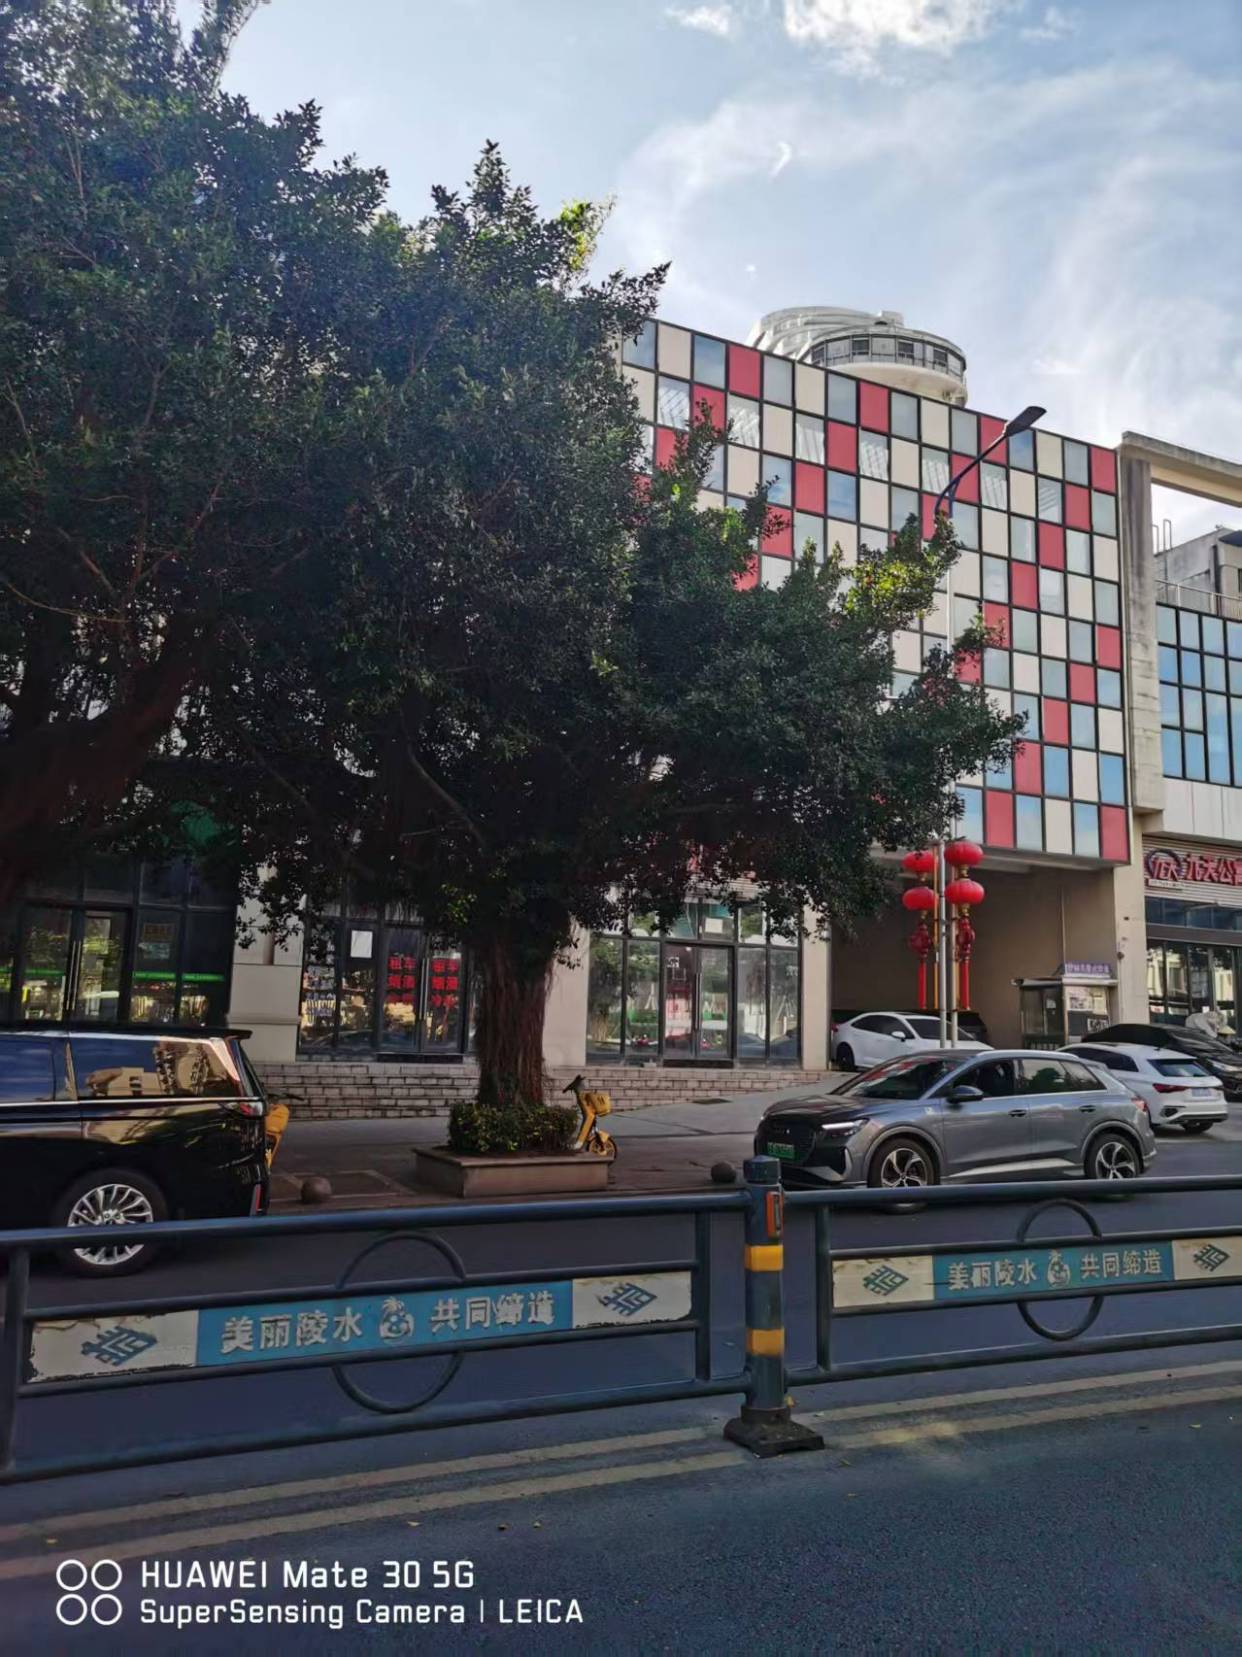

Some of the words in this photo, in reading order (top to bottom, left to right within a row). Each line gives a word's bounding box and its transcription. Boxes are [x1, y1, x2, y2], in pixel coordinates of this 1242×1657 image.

[948, 1259, 1037, 1290] 美丽陵水
[1080, 1250, 1162, 1279] 共同缔造
[221, 1307, 362, 1353] 美丽陵水
[431, 1290, 555, 1333] 共同缔造
